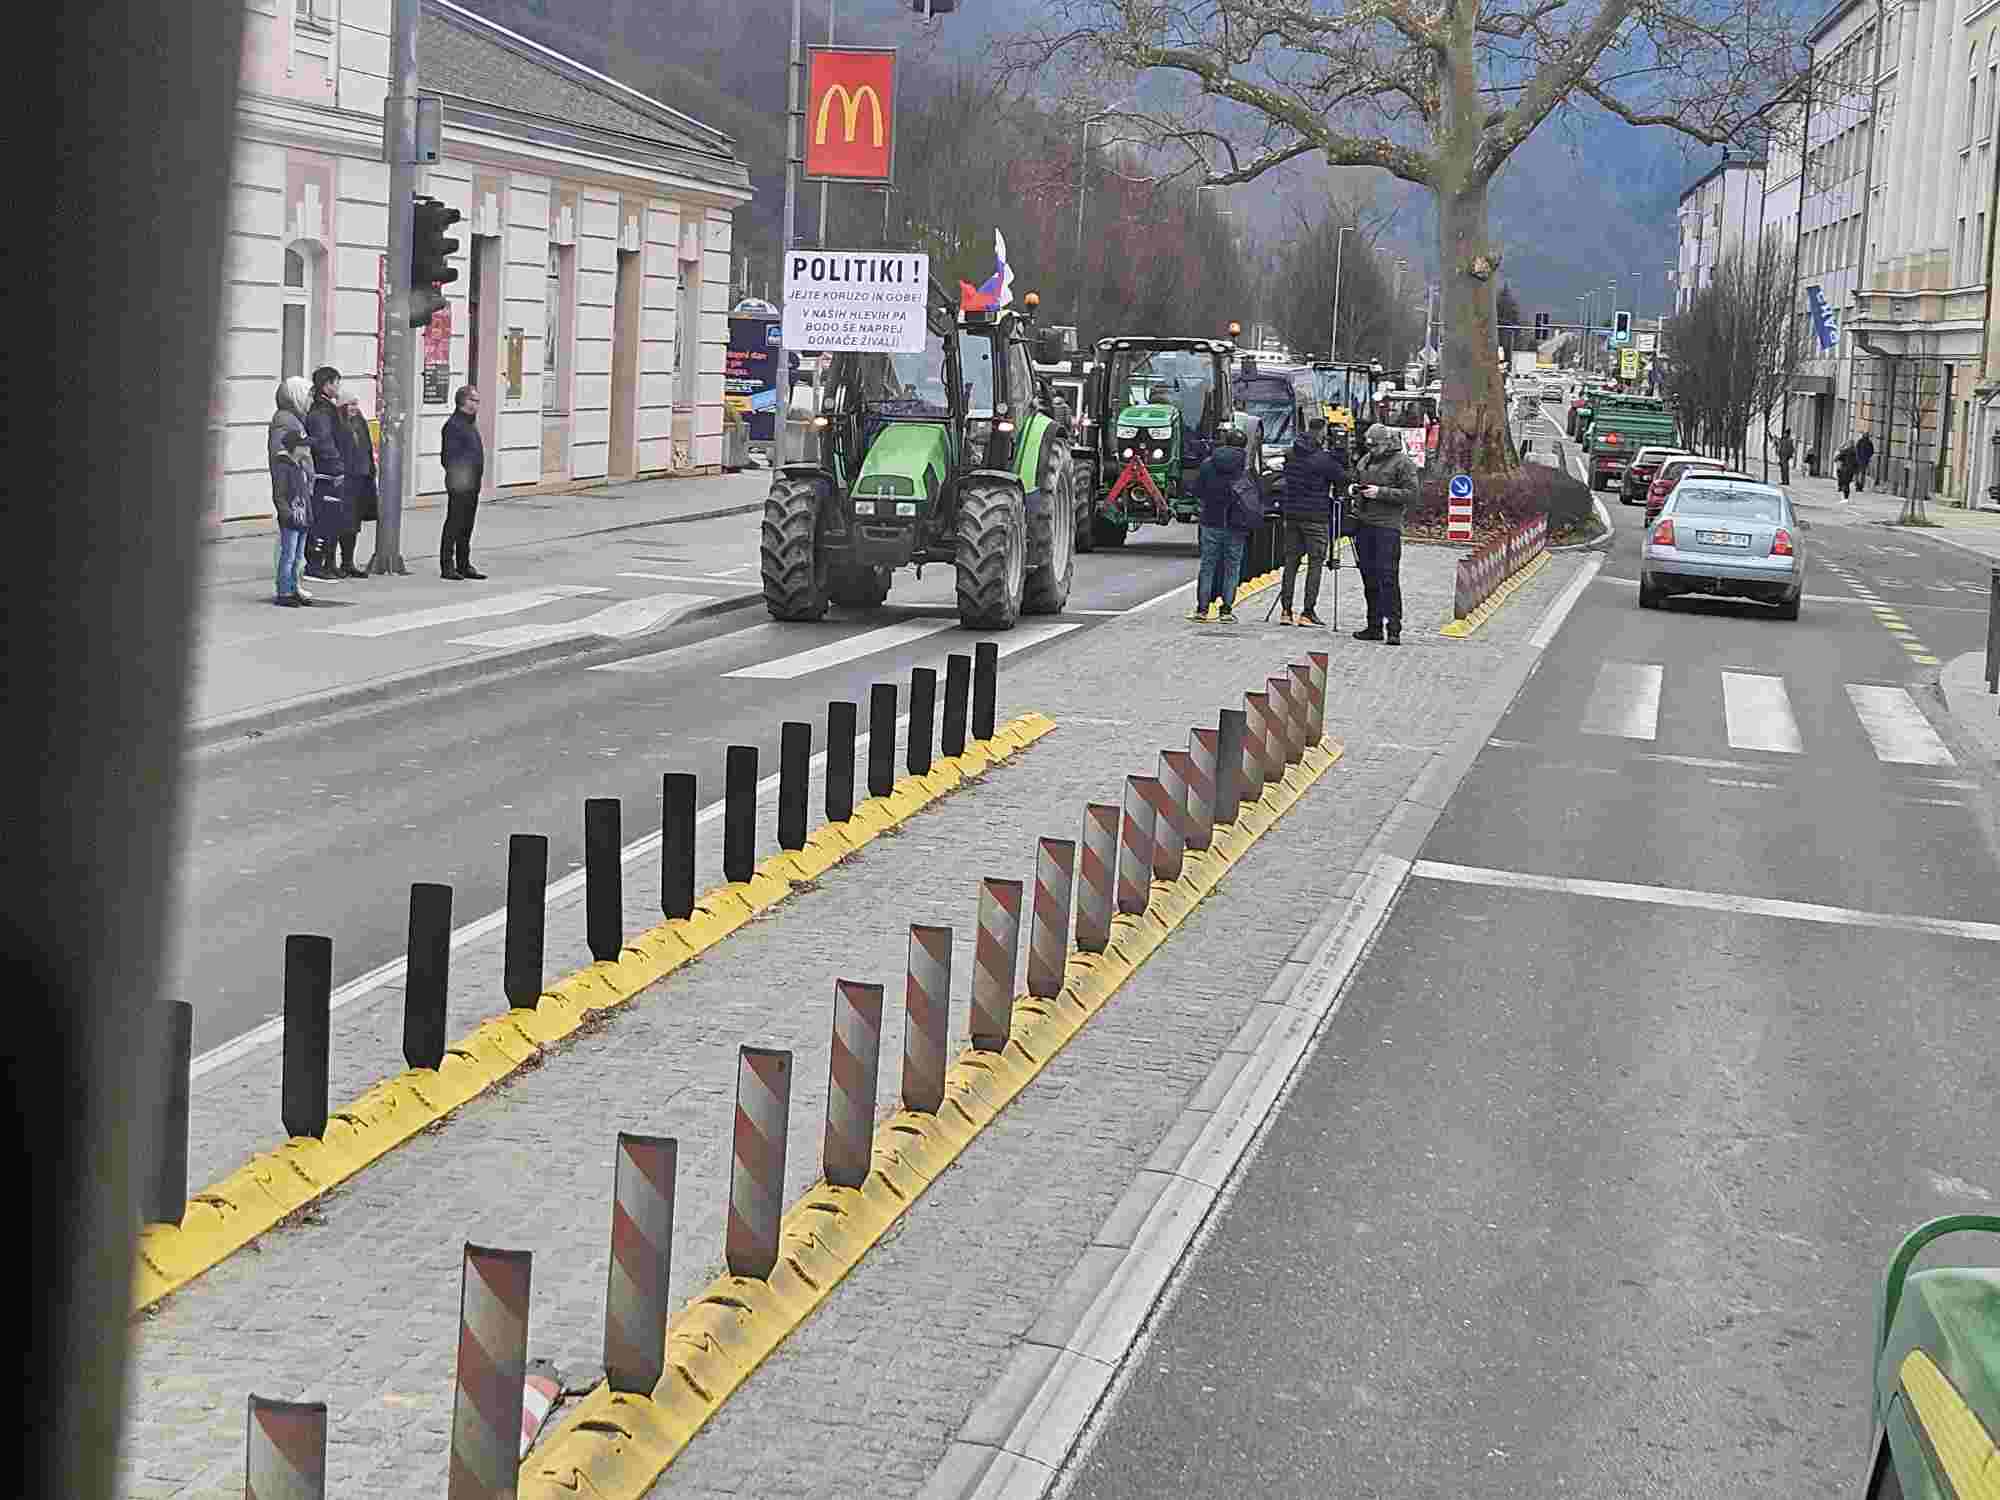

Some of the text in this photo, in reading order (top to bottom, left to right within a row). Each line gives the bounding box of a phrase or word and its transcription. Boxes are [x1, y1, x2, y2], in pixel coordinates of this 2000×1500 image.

[793, 258, 903, 282] POLITIKI
[788, 288, 820, 299] JEJTE
[823, 290, 869, 301] KORUZO
[872, 291, 883, 301] IN
[802, 308, 810, 318] V
[849, 311, 890, 320] HLEVIH
[893, 311, 907, 320] PA
[806, 322, 839, 332] BODO
[858, 323, 904, 334] NAPREJ
